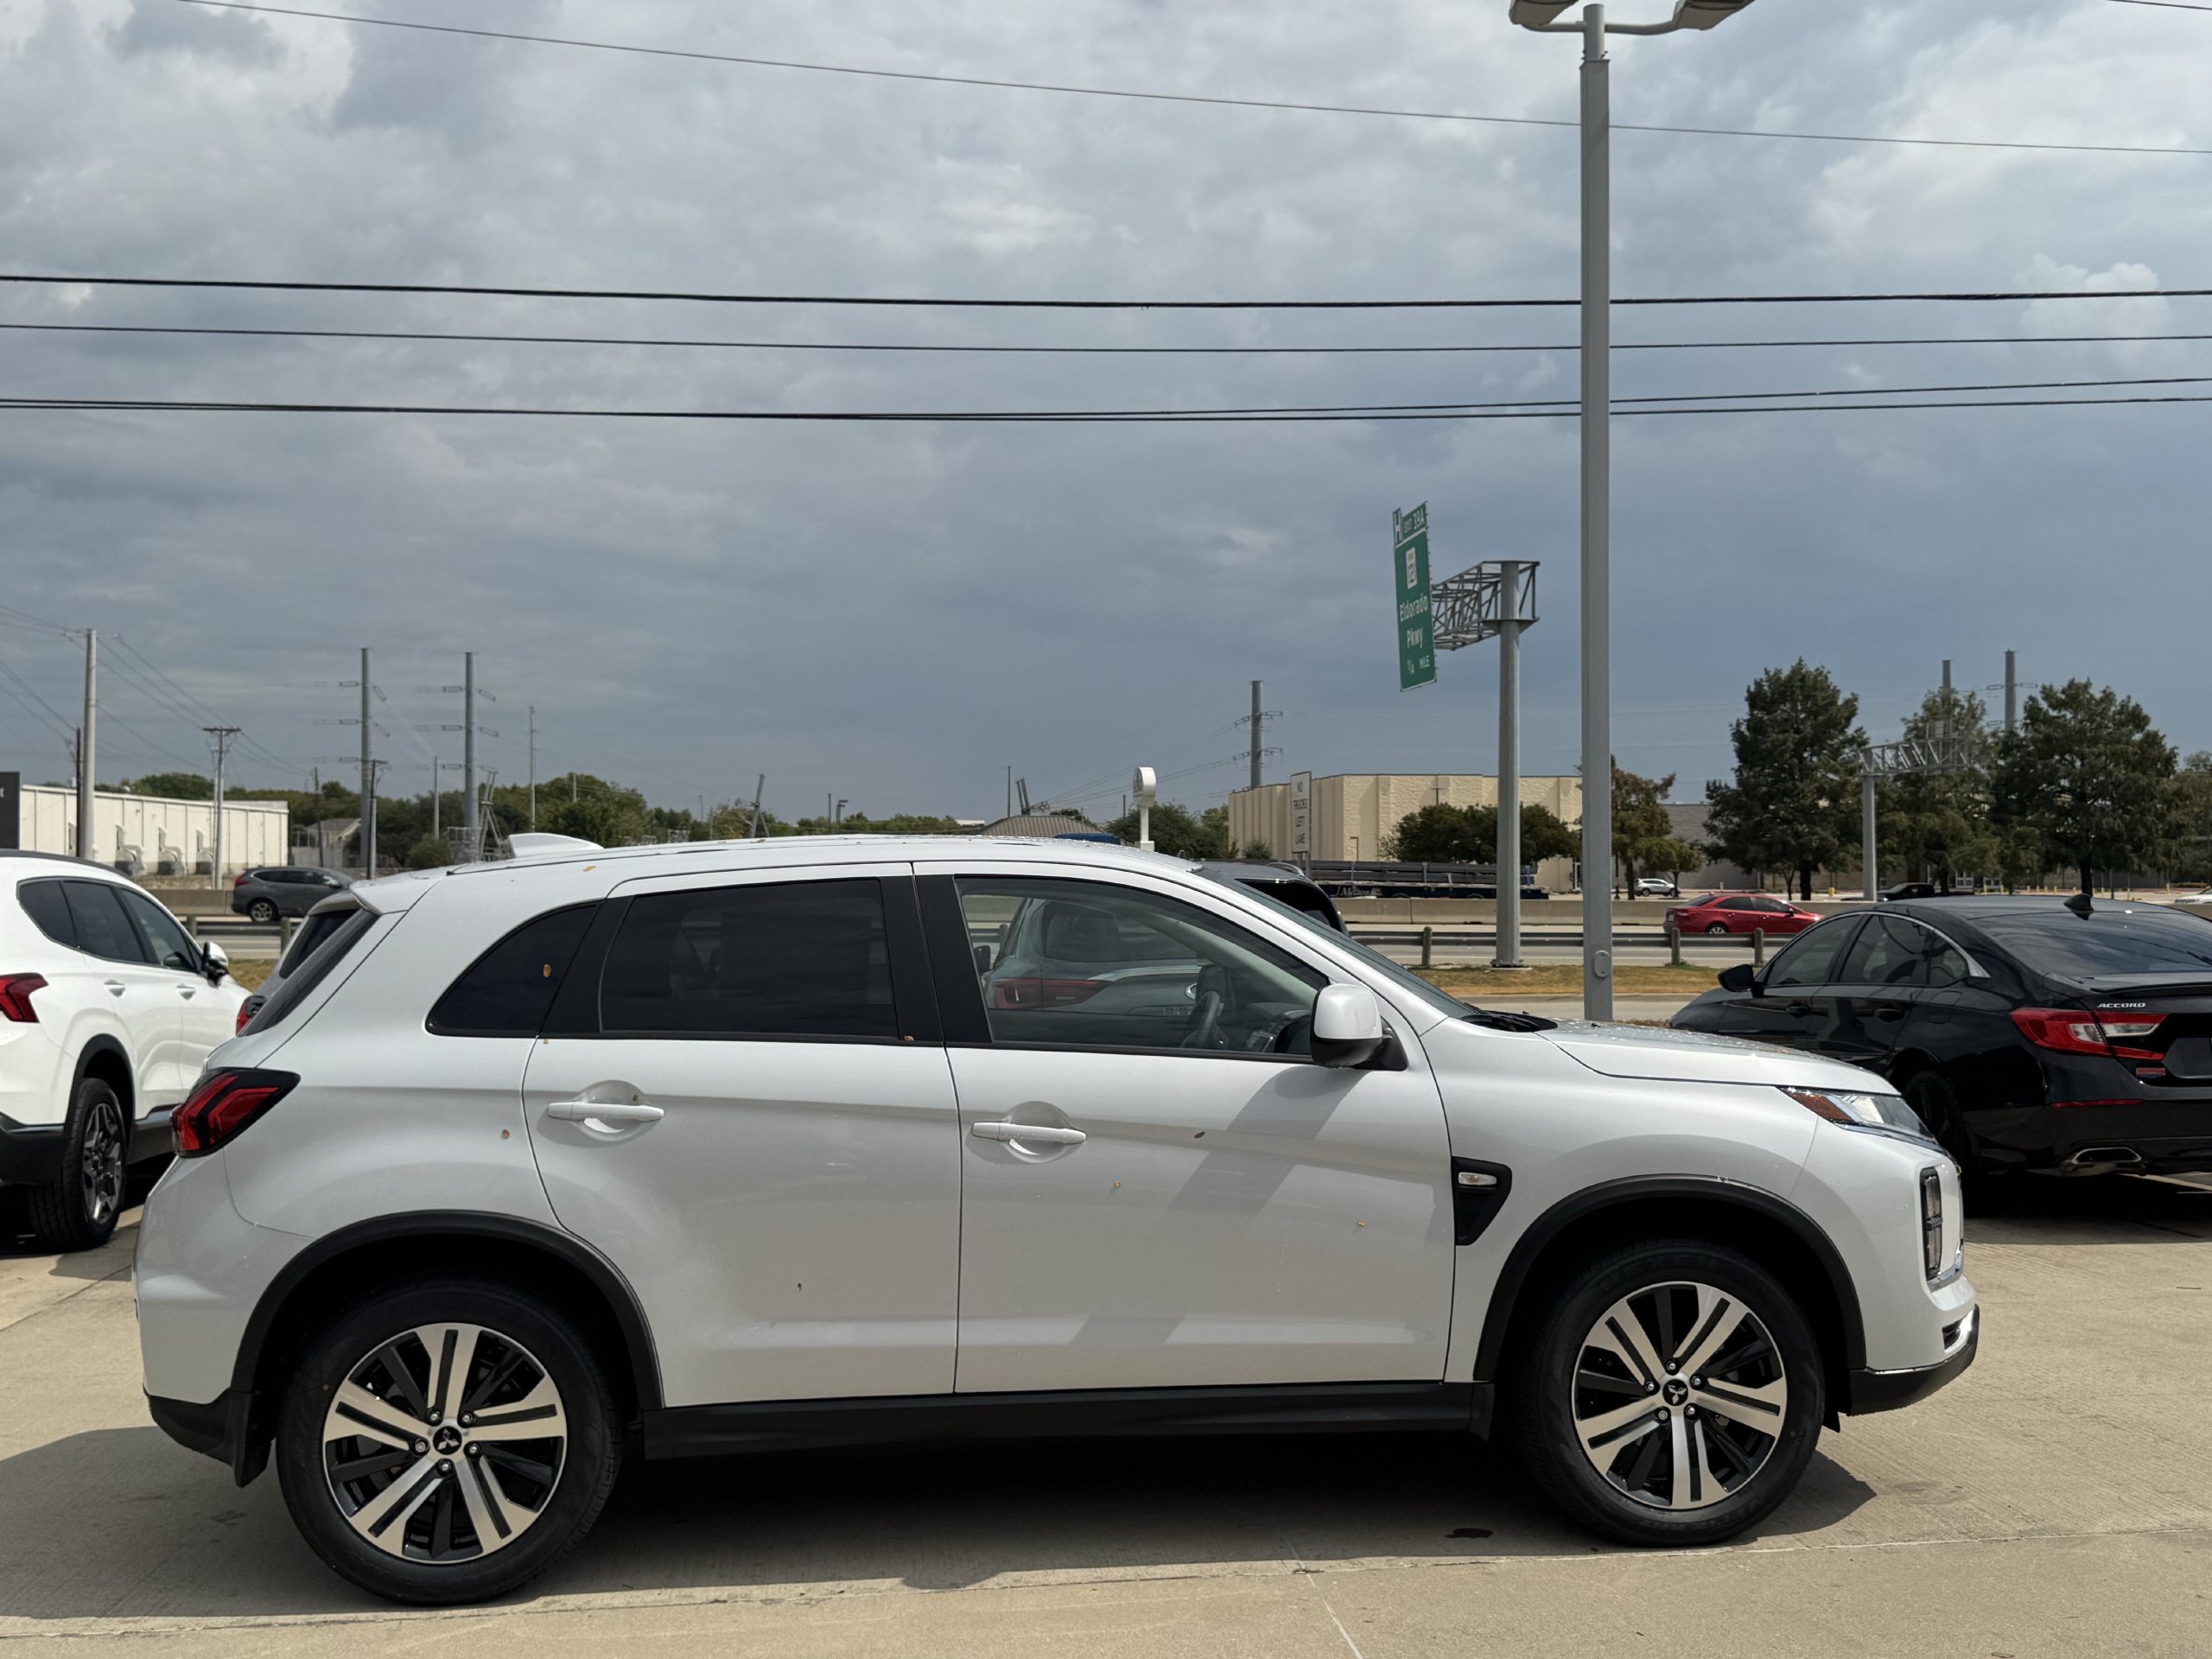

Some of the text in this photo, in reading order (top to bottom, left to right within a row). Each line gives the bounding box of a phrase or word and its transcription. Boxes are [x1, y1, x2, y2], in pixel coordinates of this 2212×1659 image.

[1400, 593, 1427, 621] Eldorado
[1407, 628, 1423, 648] Pkwy
[1293, 798, 1308, 810] TRUCKS
[1295, 816, 1306, 827] LEFT
[1295, 833, 1306, 844] LANE
